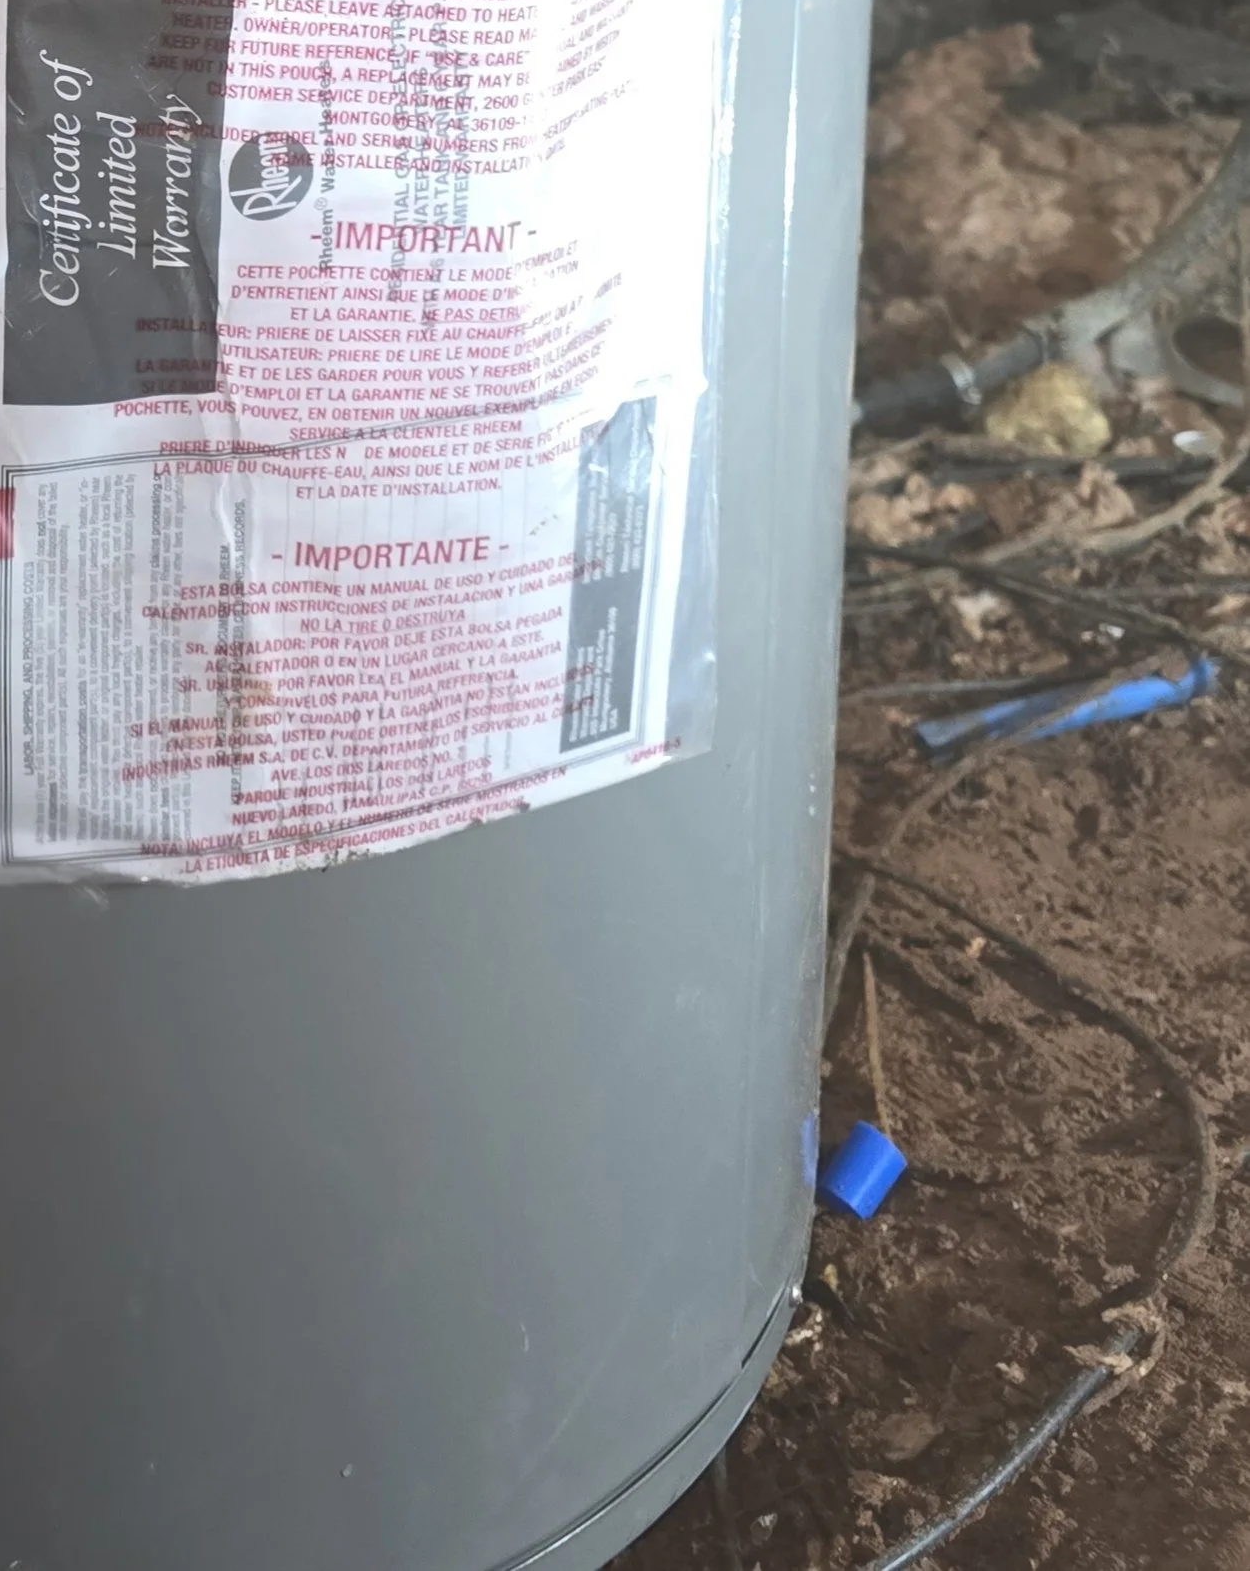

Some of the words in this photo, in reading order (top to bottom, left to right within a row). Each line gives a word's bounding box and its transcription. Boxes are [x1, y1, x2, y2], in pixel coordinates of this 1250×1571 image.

[39, 49, 93, 101] of
[96, 111, 137, 259] Limited
[152, 93, 202, 269] Warranty
[230, 131, 302, 217] Rheem
[39, 113, 92, 307] Certificate
[335, 221, 521, 253] IMPORTANT
[114, 400, 193, 417] POCHETTE,
[197, 399, 236, 413] VOUS
[308, 407, 326, 420] EN
[332, 407, 395, 421] OBTENIR
[400, 407, 420, 421] UN
[296, 486, 314, 499] ET
[318, 486, 336, 498] LA
[341, 484, 377, 498] DATE
[295, 536, 490, 571] IMPORTANTE
[181, 585, 216, 600] ESTA
[272, 581, 342, 597] CONTIENE
[347, 584, 366, 596] UN
[370, 577, 429, 594] MANUAL
[434, 575, 452, 589] DE
[455, 573, 483, 586] USO
[487, 572, 496, 582] Y
[499, 560, 555, 586] CUIDADO
[185, 861, 201, 874] LA
[207, 852, 270, 871] ETIQUETA
[275, 849, 290, 861] DE
[419, 819, 441, 834] DEL
